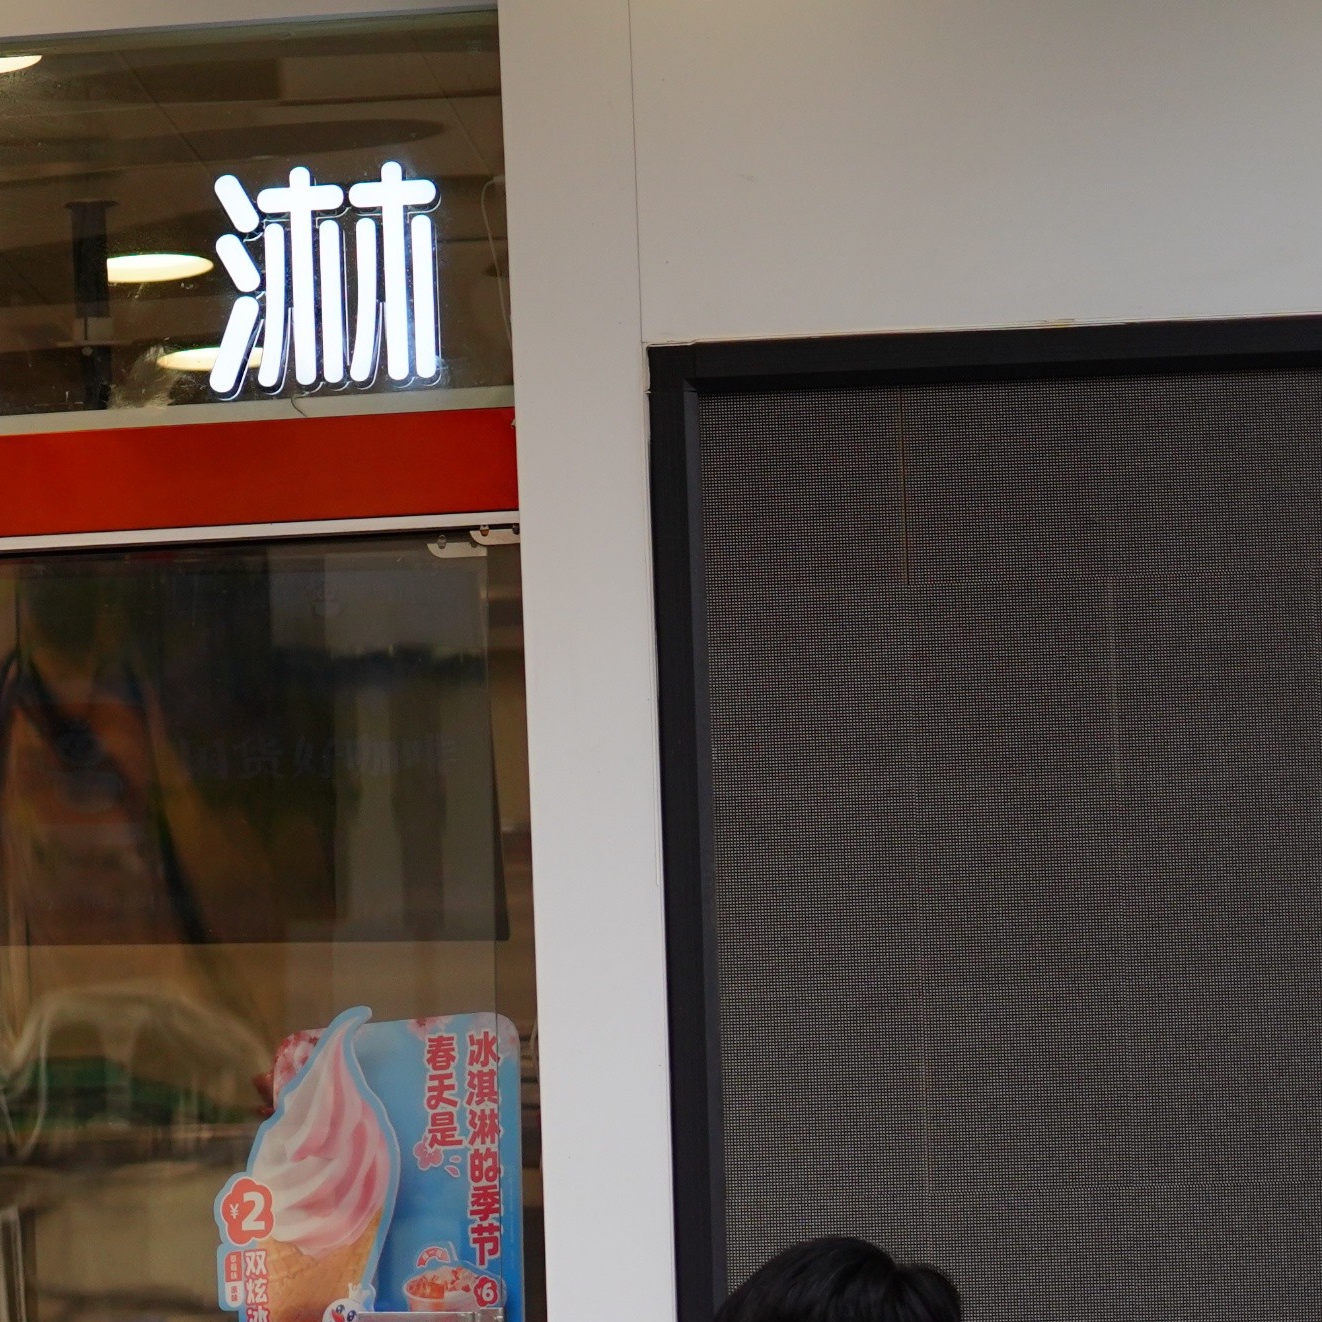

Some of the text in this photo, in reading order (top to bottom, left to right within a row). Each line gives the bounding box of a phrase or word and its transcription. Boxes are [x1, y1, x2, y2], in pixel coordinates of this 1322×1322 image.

[425, 1034, 463, 1149] 春天是
[466, 1030, 501, 1266] 冰淇淋的季节
